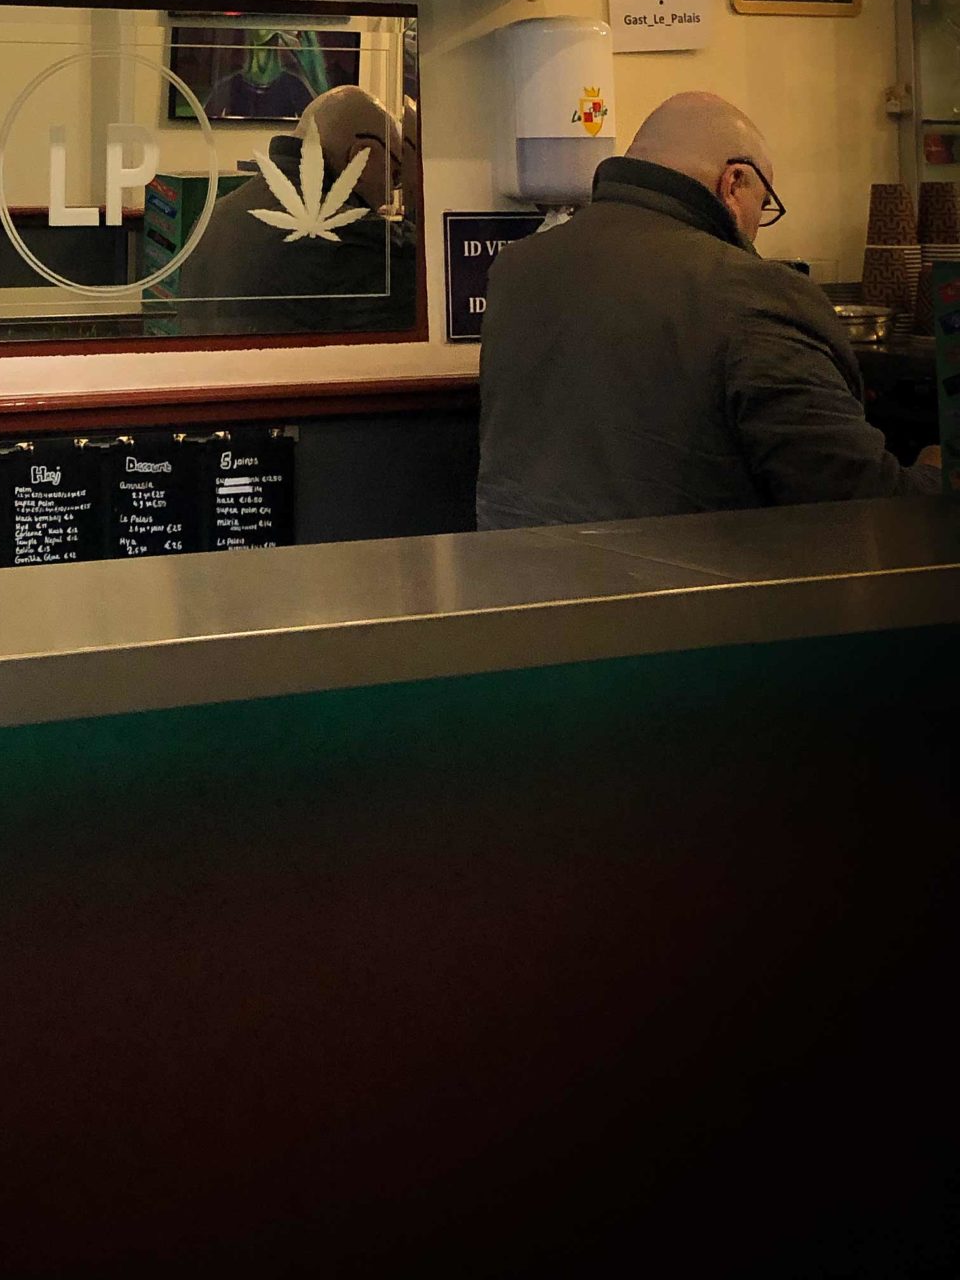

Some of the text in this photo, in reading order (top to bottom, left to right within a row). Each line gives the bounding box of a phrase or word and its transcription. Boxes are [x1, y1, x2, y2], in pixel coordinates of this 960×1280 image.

[624, 13, 701, 27] Gast_Le_Palais
[48, 123, 159, 227] LP
[464, 241, 481, 257] ID
[469, 297, 486, 313] ID
